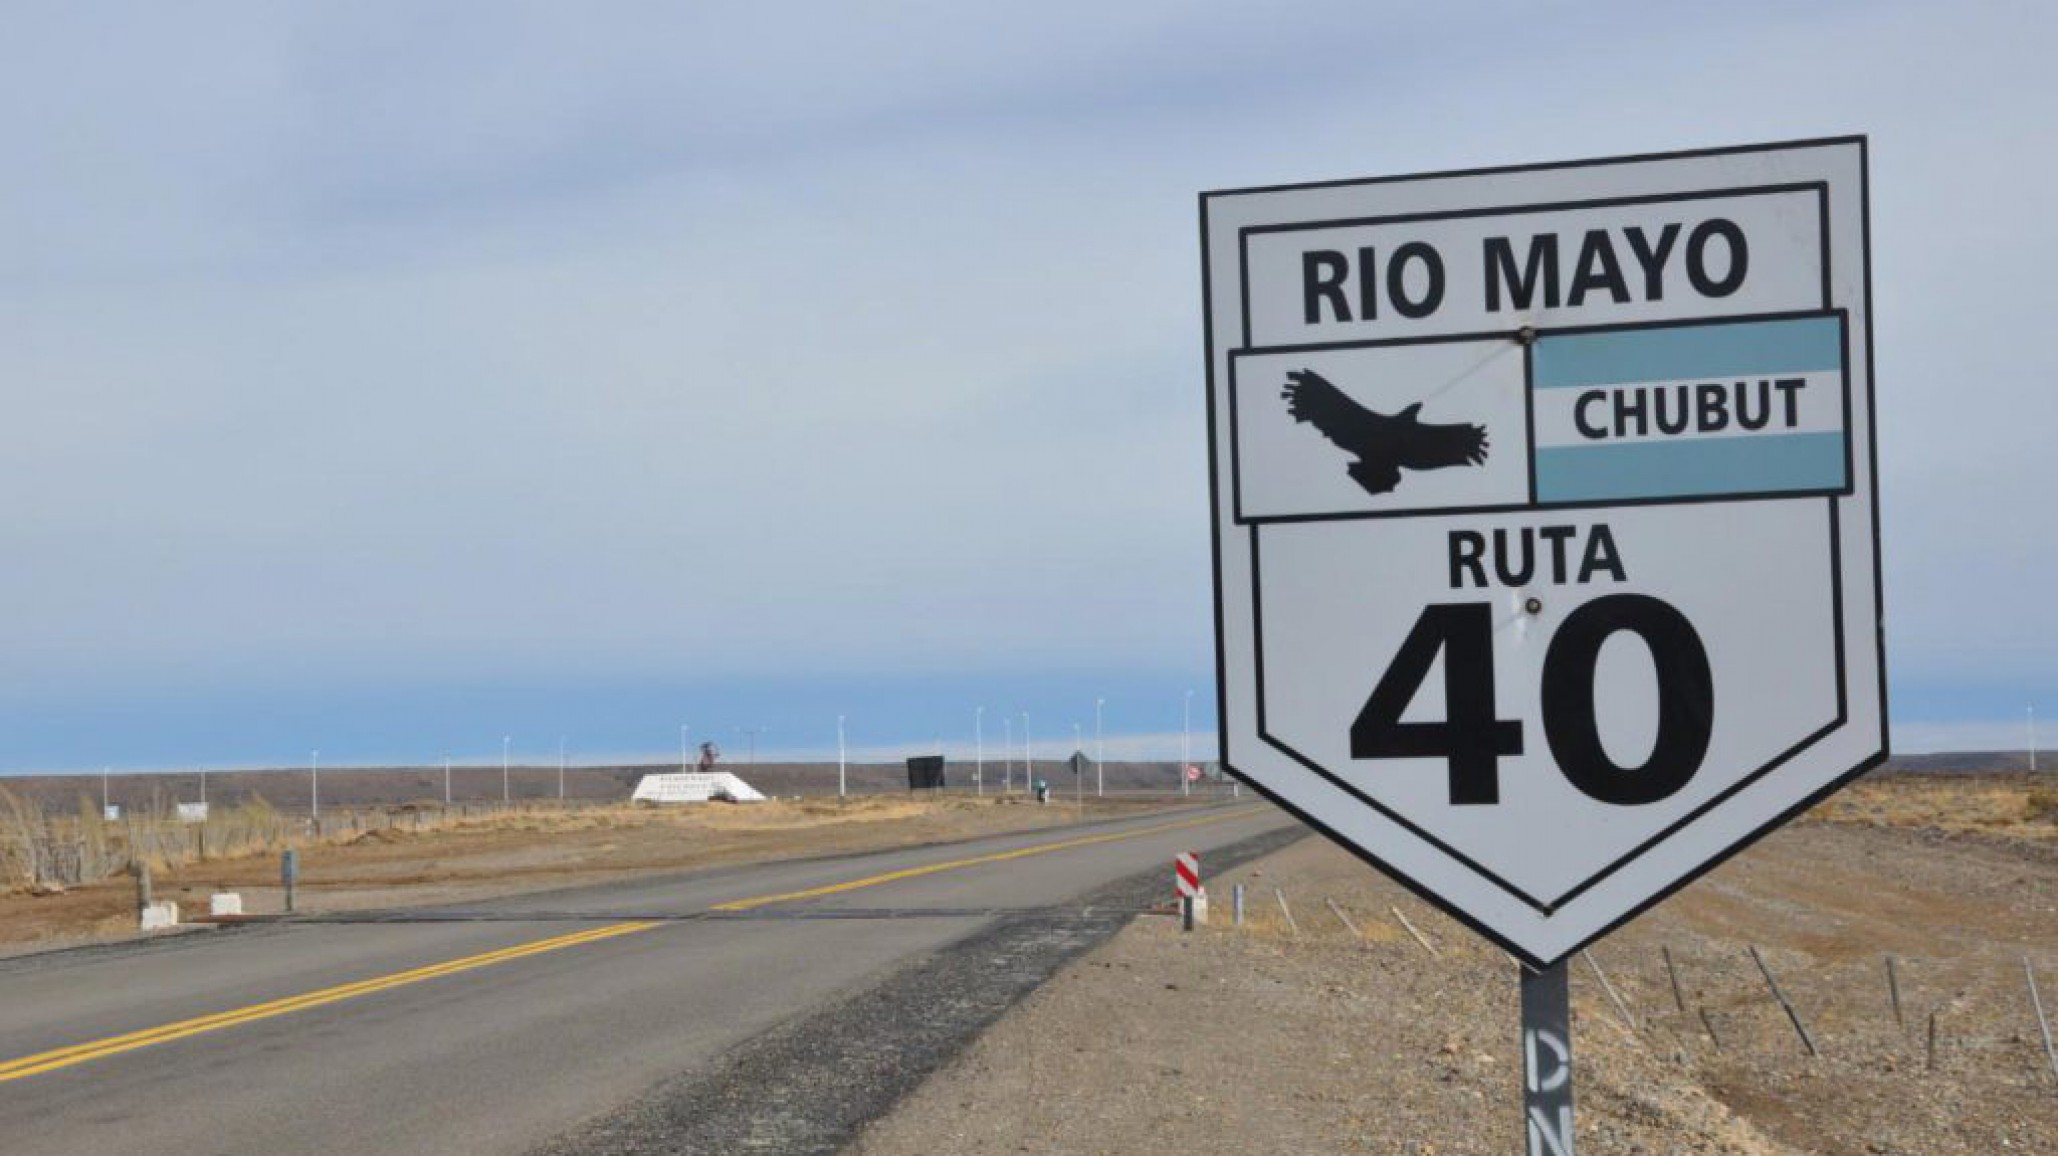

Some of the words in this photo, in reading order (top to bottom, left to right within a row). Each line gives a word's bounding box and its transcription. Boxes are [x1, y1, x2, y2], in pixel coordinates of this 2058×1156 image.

[1302, 241, 1446, 325] RIO
[1483, 218, 1749, 313] MAYO
[1574, 377, 1806, 440] CHUBUT
[1448, 524, 1627, 588] RUTA
[1350, 592, 1715, 806] 40
